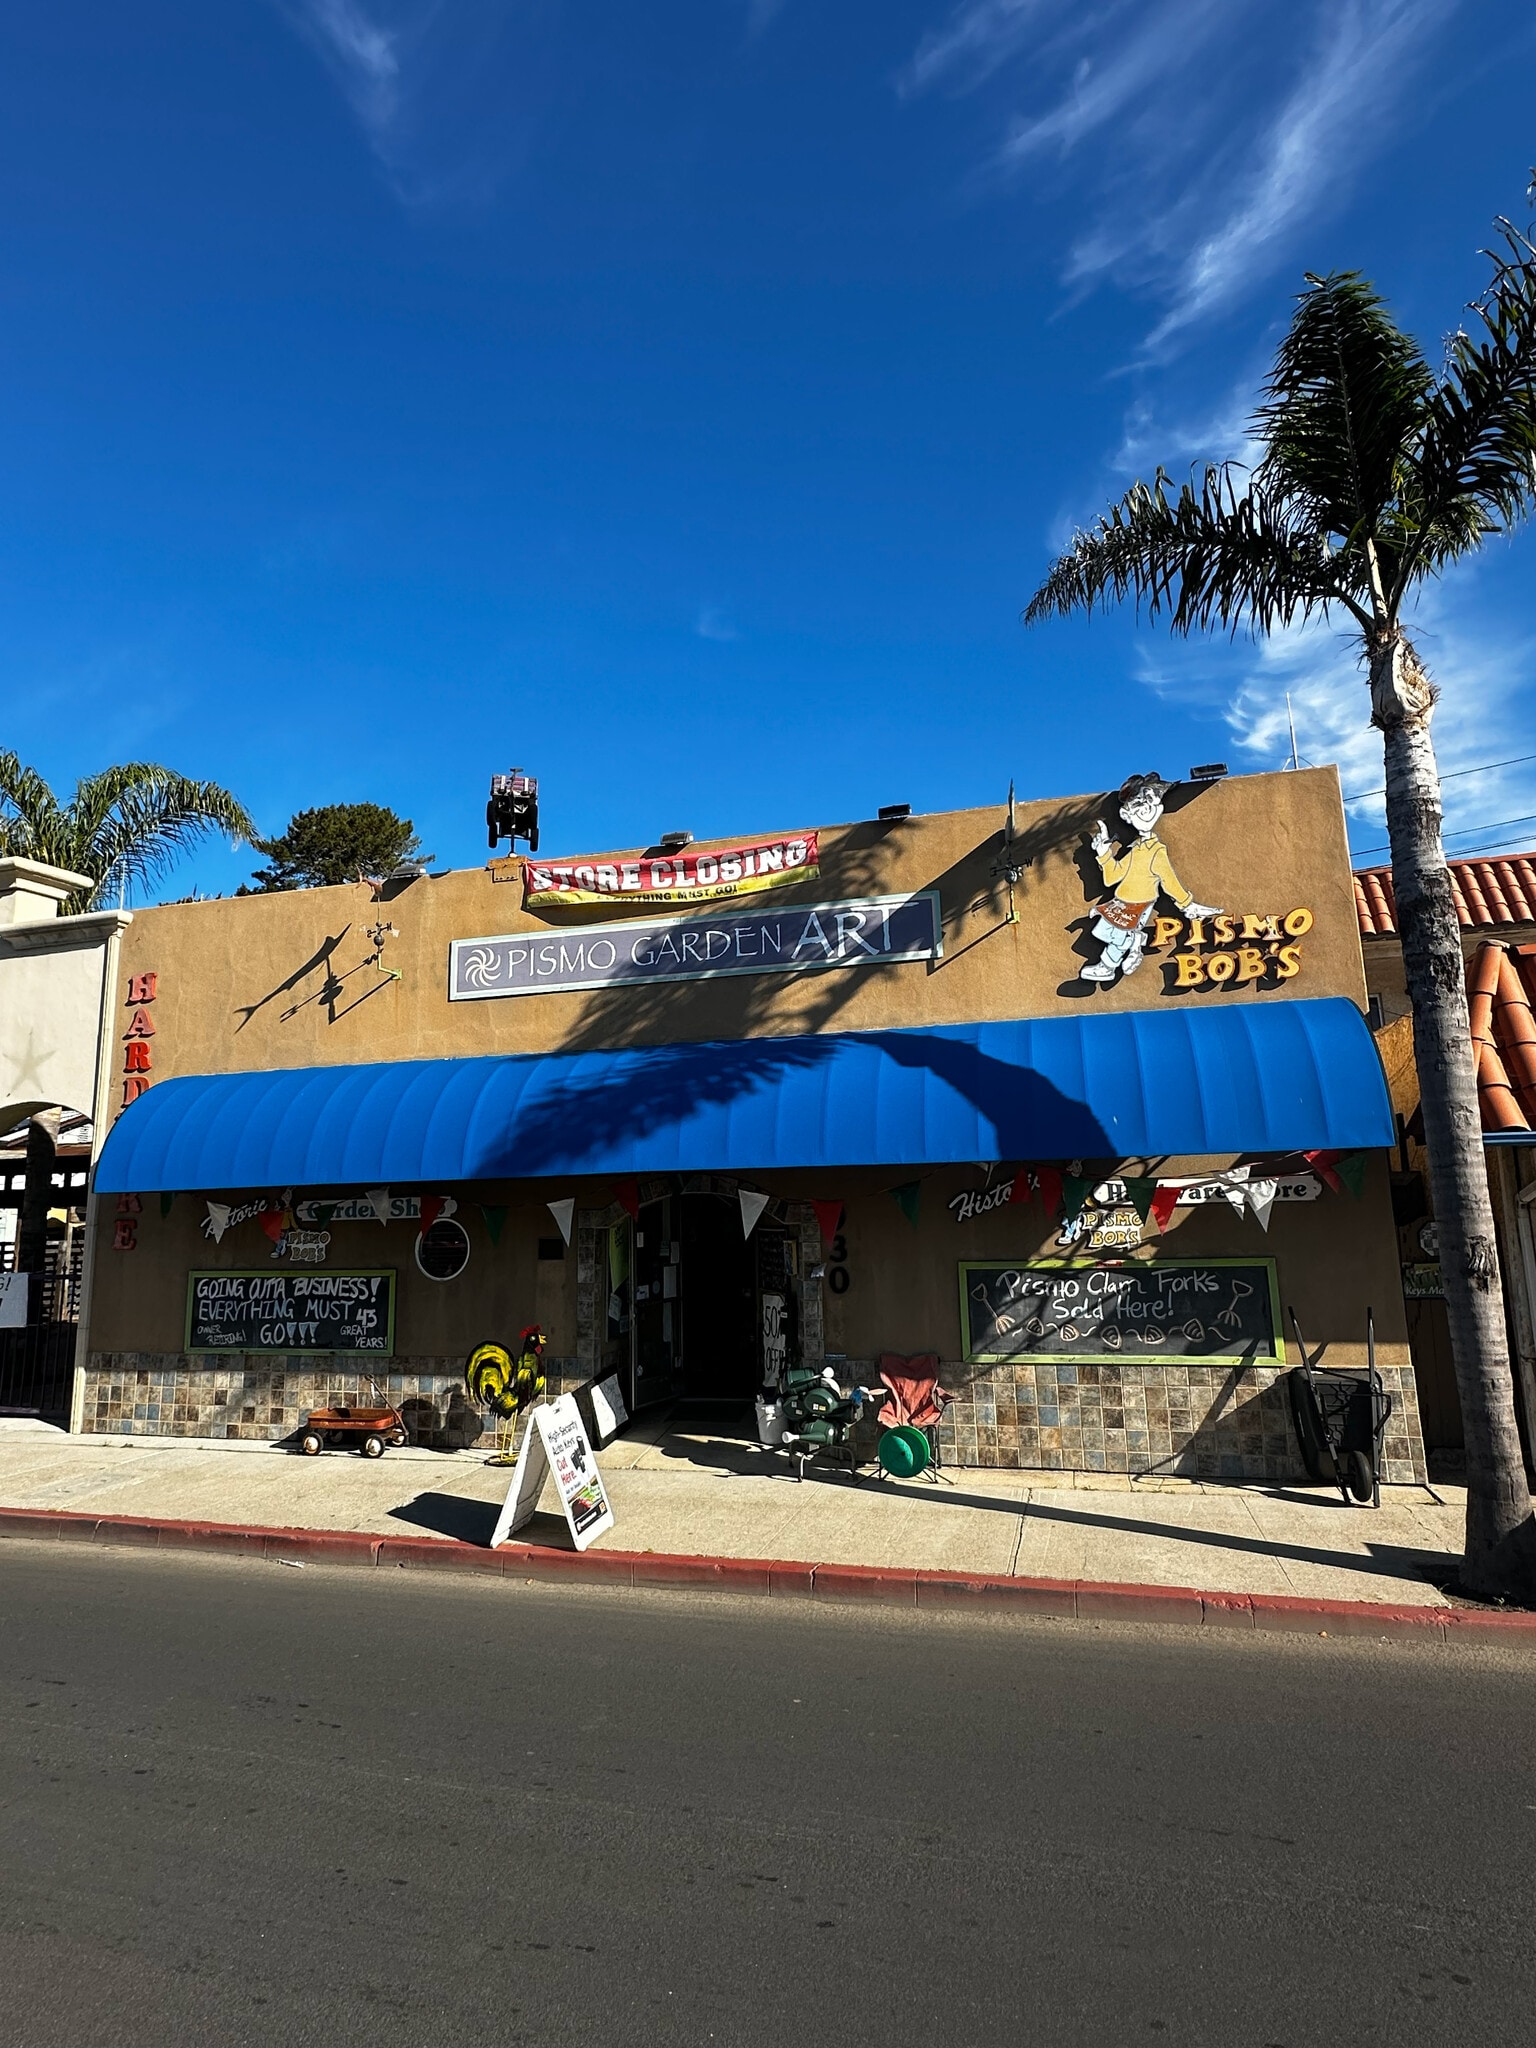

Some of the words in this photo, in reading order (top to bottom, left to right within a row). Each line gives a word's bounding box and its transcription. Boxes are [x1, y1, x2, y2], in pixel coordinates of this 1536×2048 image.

[530, 863, 643, 891] STORE
[650, 839, 808, 888] CLOSING
[677, 887, 710, 901] MUST
[1150, 906, 1315, 949] PISMO
[508, 939, 617, 979] PISMO
[631, 923, 782, 967] GARDEN
[791, 901, 920, 960] ART
[1175, 946, 1302, 988] BOB'S
[948, 1173, 1040, 1222] Histoic
[1084, 1212, 1142, 1227] PISMO
[289, 1231, 330, 1246] PISMO
[197, 1278, 246, 1299] GOING
[249, 1277, 286, 1301] OUTTA
[292, 1277, 381, 1303] BUSINESS!
[996, 1271, 1080, 1299] Pismo
[1086, 1271, 1146, 1296] Clam
[1152, 1268, 1220, 1294] Forks
[1405, 1286, 1426, 1297] Keys
[198, 1298, 295, 1322] EVERYTHING
[305, 1299, 355, 1320] MUST
[356, 1308, 377, 1328] 43
[1116, 1297, 1175, 1319] Here!
[260, 1321, 320, 1346] GO!!!
[340, 1325, 368, 1336] GREAT
[355, 1336, 388, 1349] YEARS!
